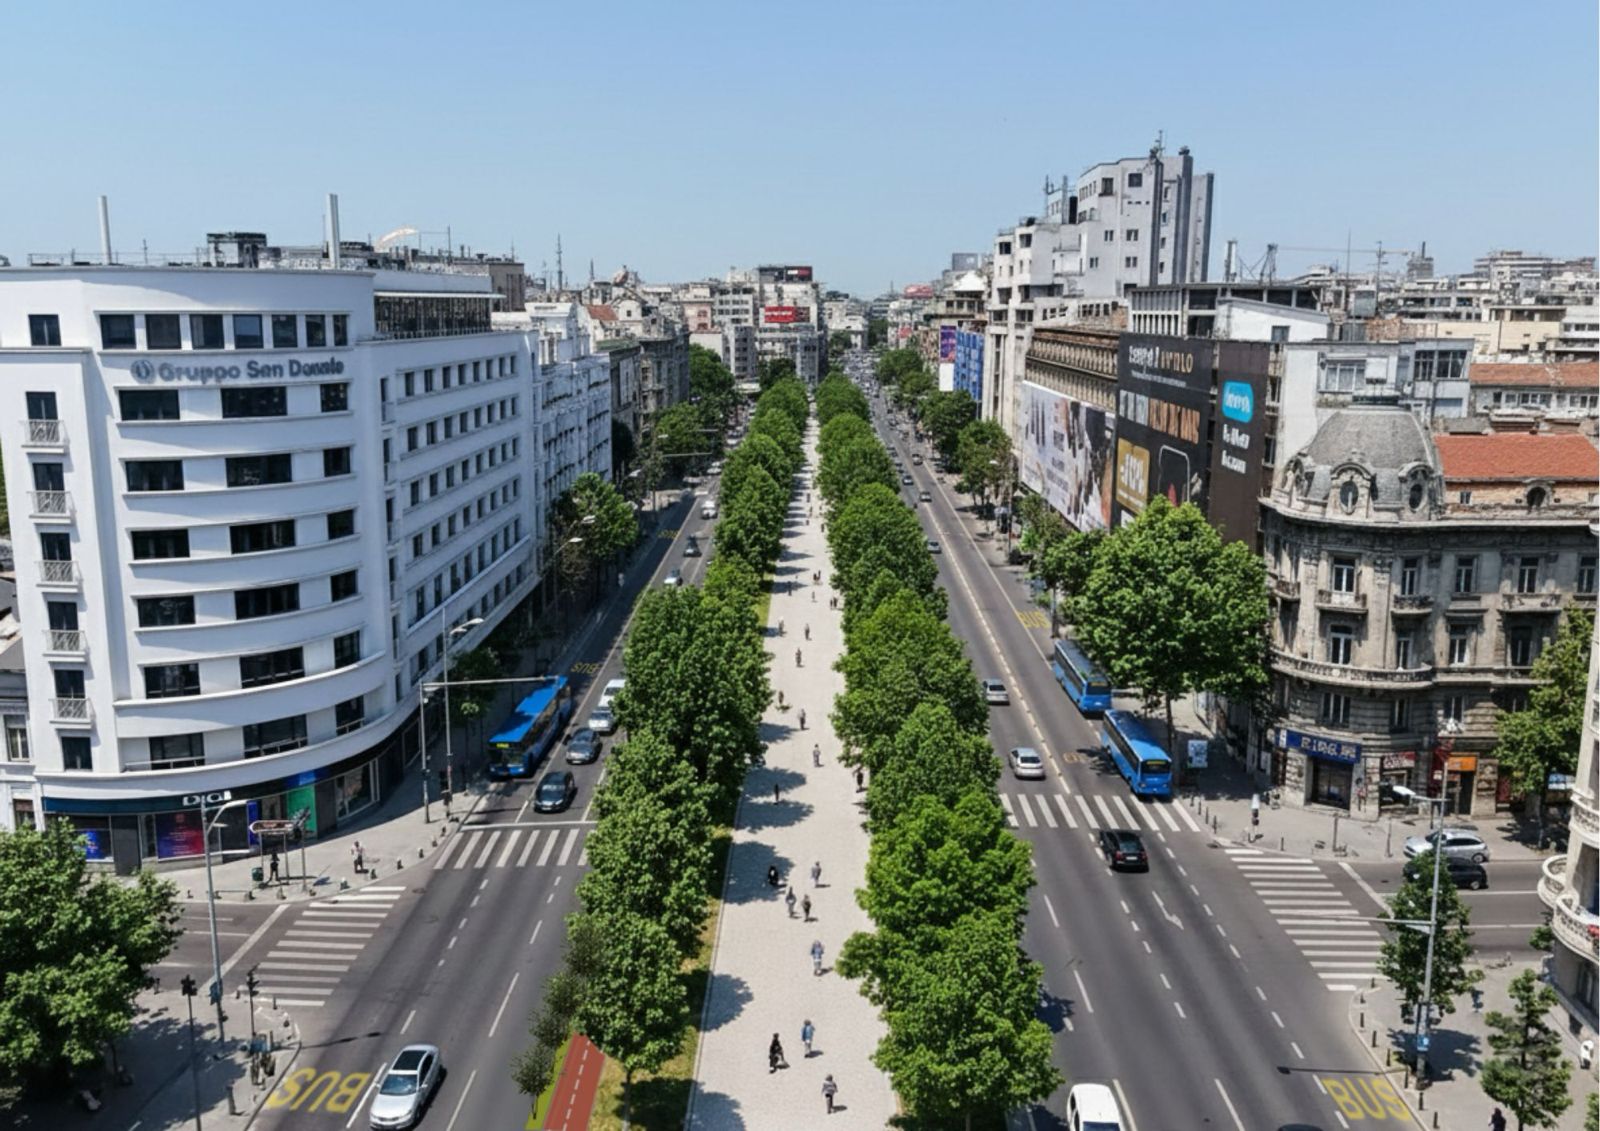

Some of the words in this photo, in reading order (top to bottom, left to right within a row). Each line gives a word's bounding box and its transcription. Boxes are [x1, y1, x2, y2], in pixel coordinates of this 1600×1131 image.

[158, 361, 241, 384] Gruppo
[1017, 610, 1050, 629] BUS
[571, 662, 599, 674] BUS
[266, 1066, 372, 1114] BUS
[1321, 1076, 1412, 1121] BUS
